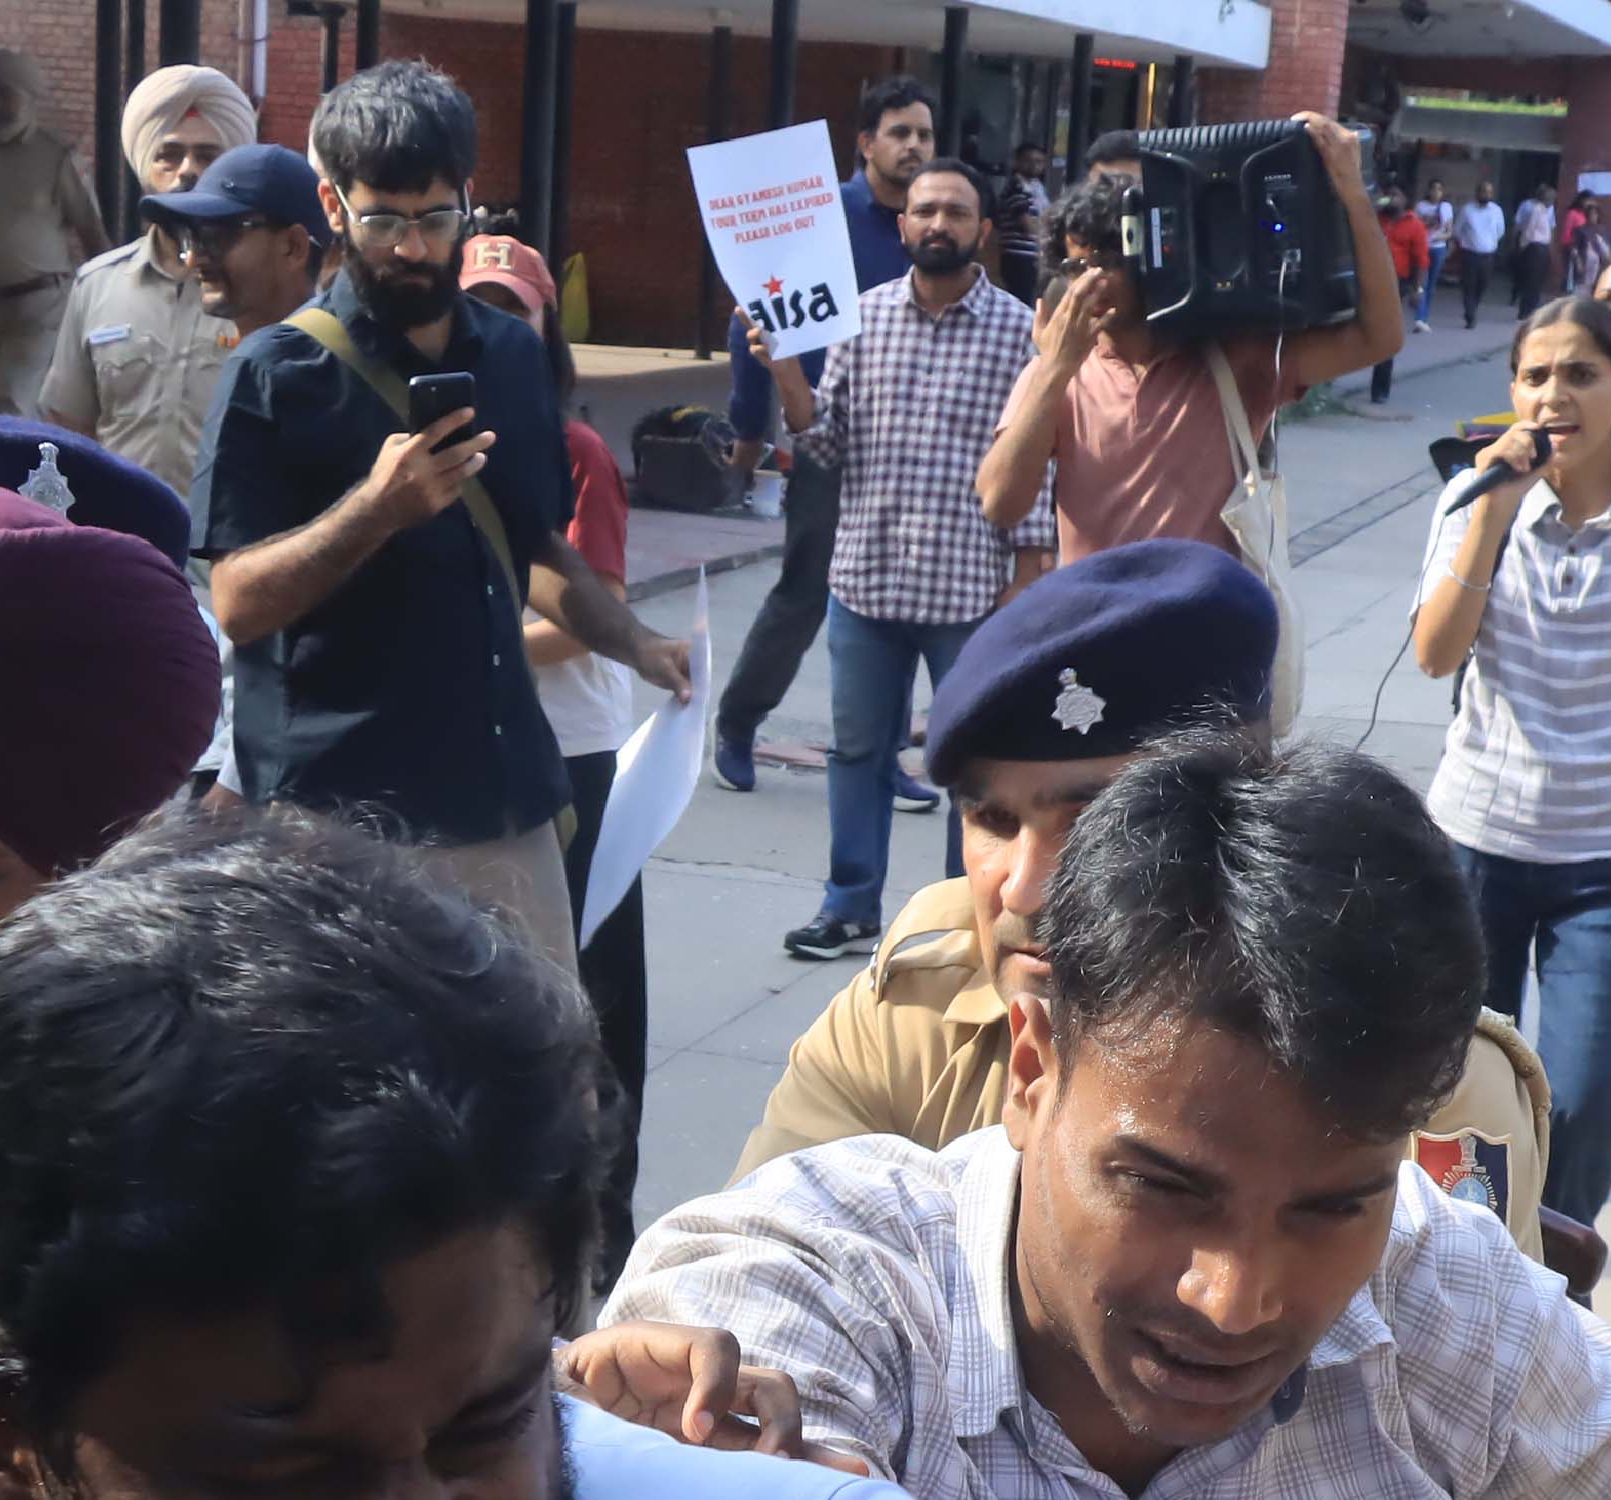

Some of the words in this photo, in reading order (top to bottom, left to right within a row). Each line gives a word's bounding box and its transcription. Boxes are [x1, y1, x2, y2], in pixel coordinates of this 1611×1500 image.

[711, 214, 738, 229] YOUR
[769, 203, 789, 217] HAS
[734, 226, 771, 244] PLEASE
[773, 221, 792, 236] LOG
[794, 214, 815, 231] OUT
[473, 242, 511, 270] H
[747, 272, 839, 334] aisa
